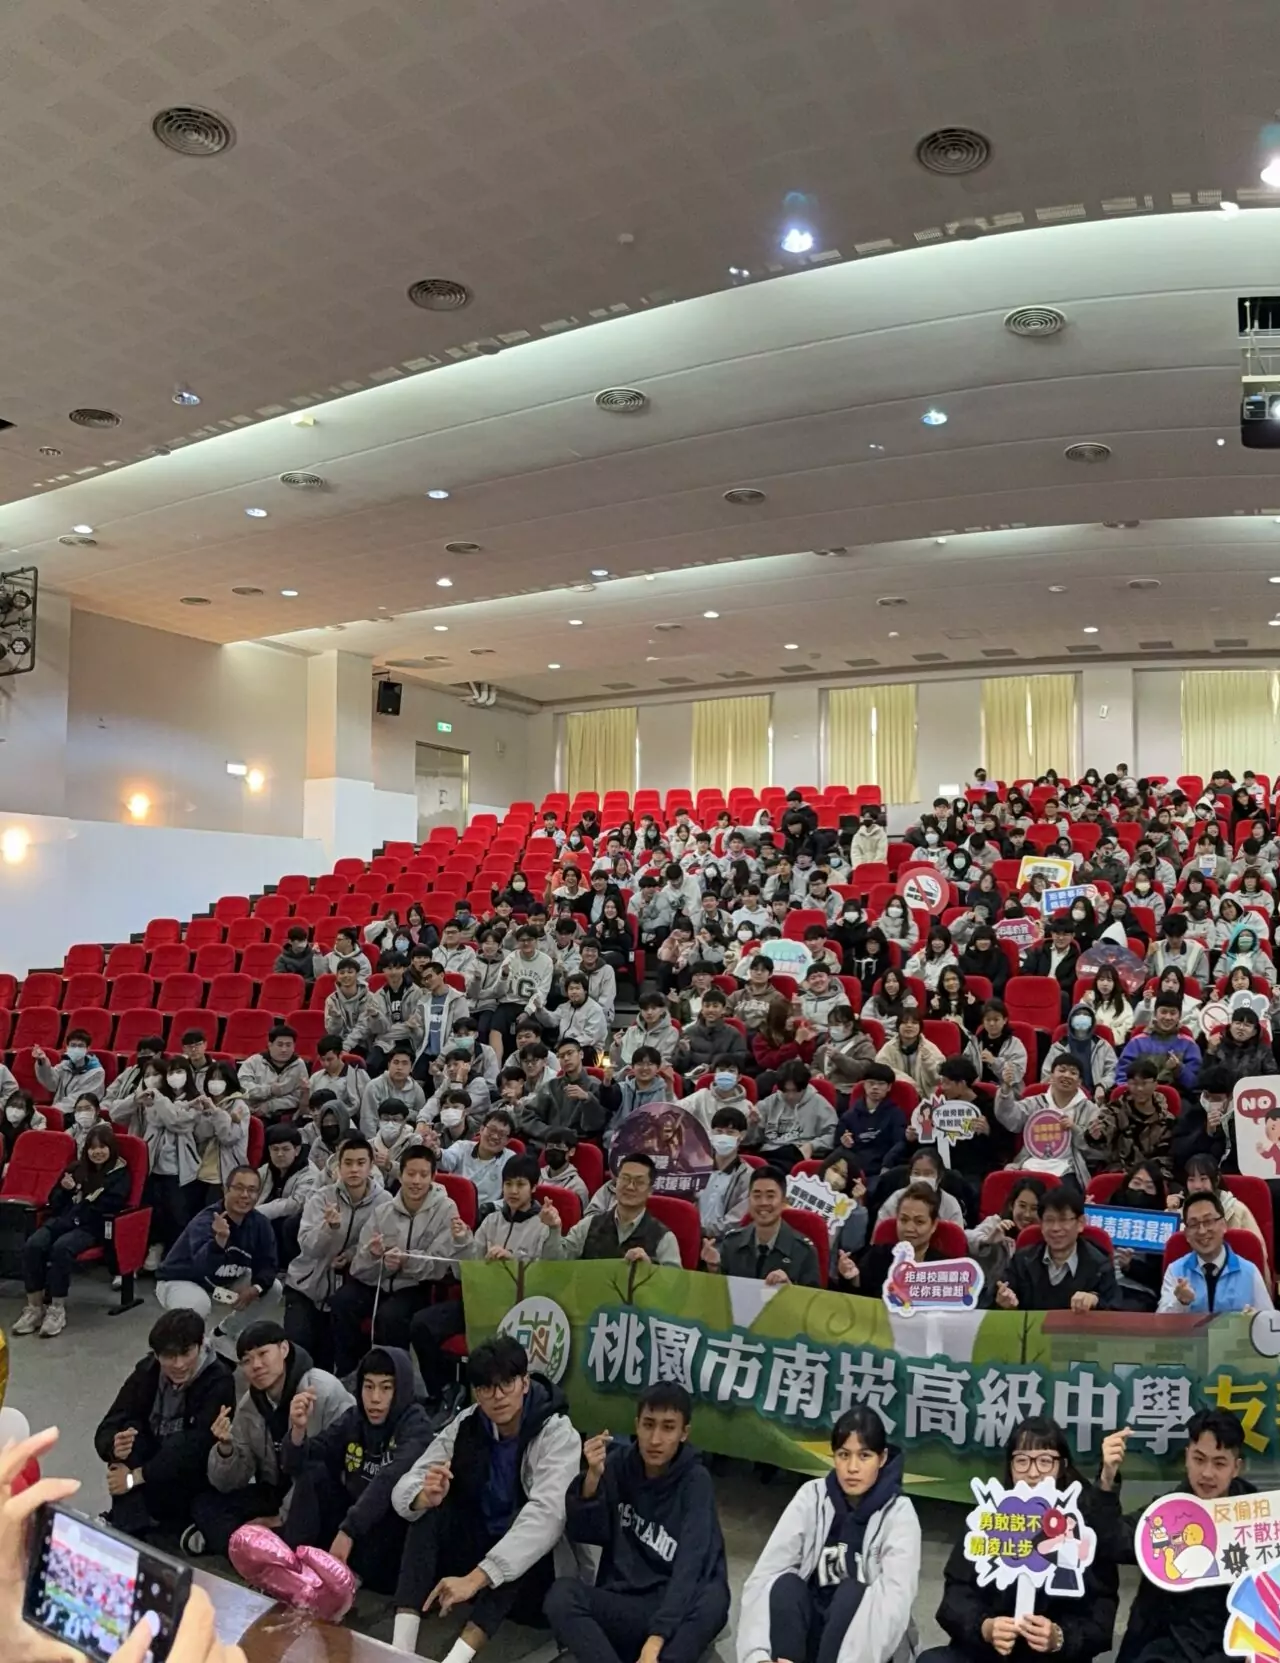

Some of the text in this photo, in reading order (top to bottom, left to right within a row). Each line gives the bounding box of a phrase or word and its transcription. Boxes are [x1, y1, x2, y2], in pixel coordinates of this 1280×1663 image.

[1241, 1095, 1272, 1111] NO
[905, 1271, 970, 1283] 拒絕校園霸凌
[909, 1285, 964, 1297] 從你我做起
[1214, 1499, 1271, 1525] 反偷拍
[969, 1536, 1033, 1558] 霸凌止步
